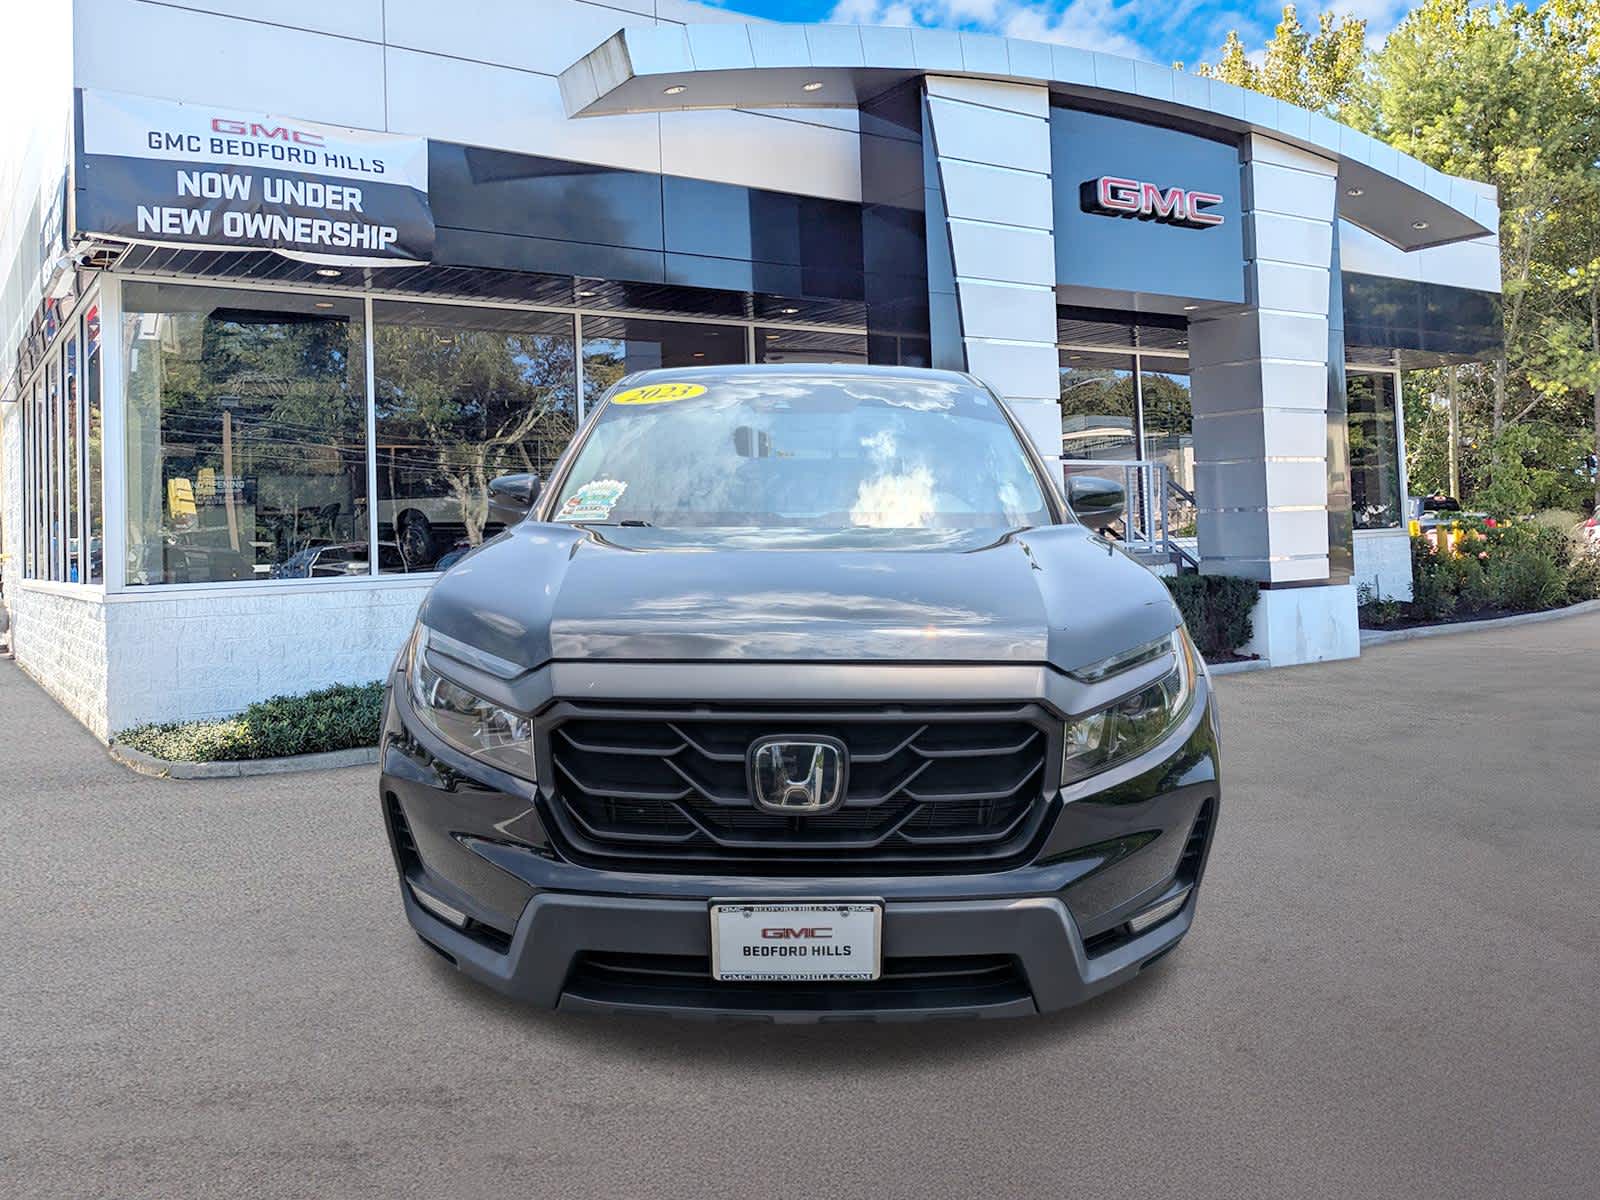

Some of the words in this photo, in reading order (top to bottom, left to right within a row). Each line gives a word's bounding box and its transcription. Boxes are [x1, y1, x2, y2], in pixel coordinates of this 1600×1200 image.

[147, 131, 201, 152] GMC
[210, 138, 317, 165] BEDFORD
[324, 153, 385, 174] HILLS
[210, 117, 326, 148] GMC
[176, 170, 252, 201] NOW
[263, 176, 364, 213] UNDER
[1097, 175, 1225, 225] GMC
[136, 205, 212, 236] NEW
[223, 210, 398, 250] OWNERSHIP
[743, 945, 808, 957] BEDFORD
[811, 945, 852, 956] HILLS
[761, 927, 833, 939] GMC
